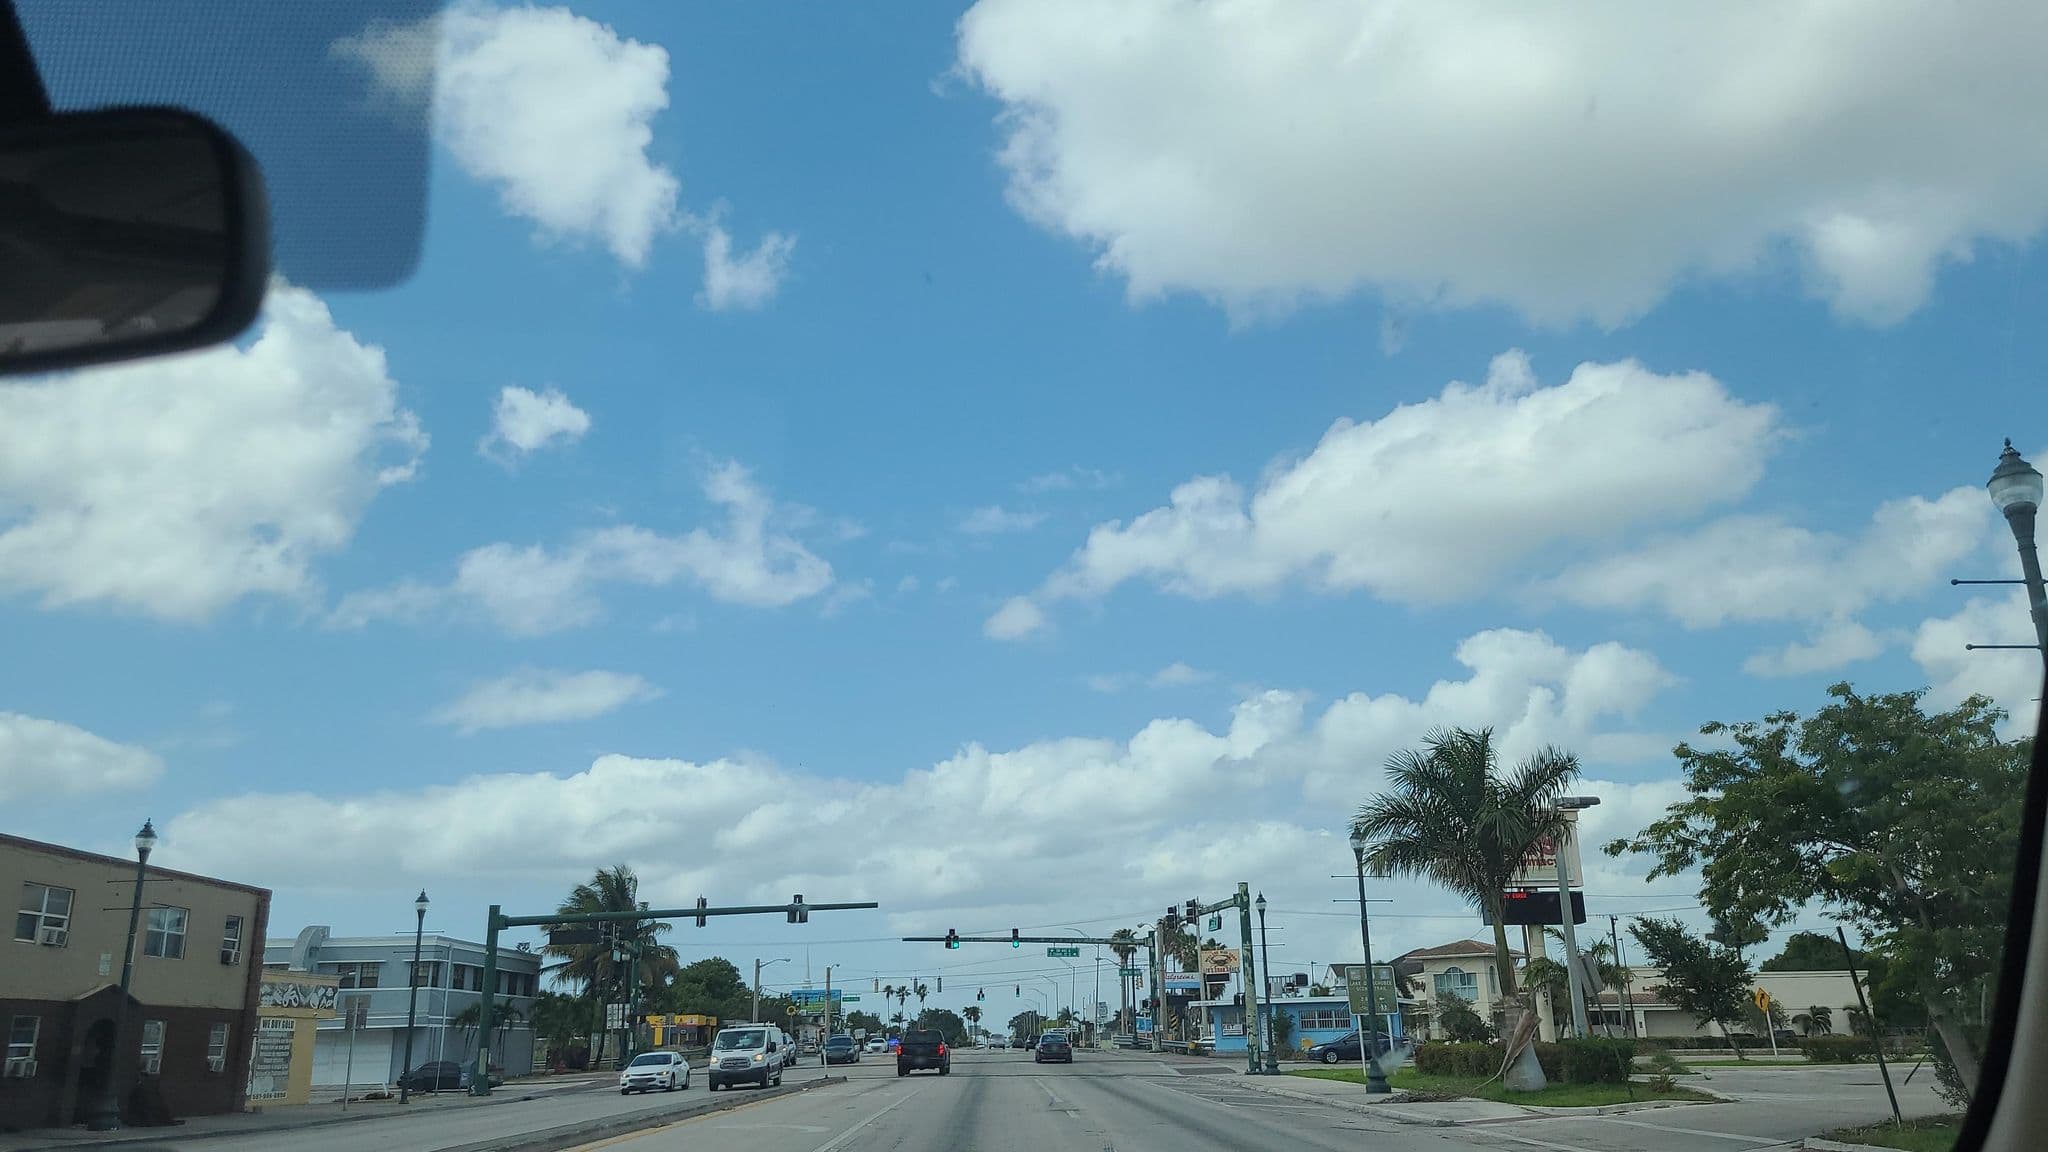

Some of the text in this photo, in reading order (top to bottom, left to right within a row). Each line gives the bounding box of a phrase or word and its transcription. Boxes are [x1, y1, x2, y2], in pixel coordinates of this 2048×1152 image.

[262, 1019, 295, 1029] WE BUY GOLD
